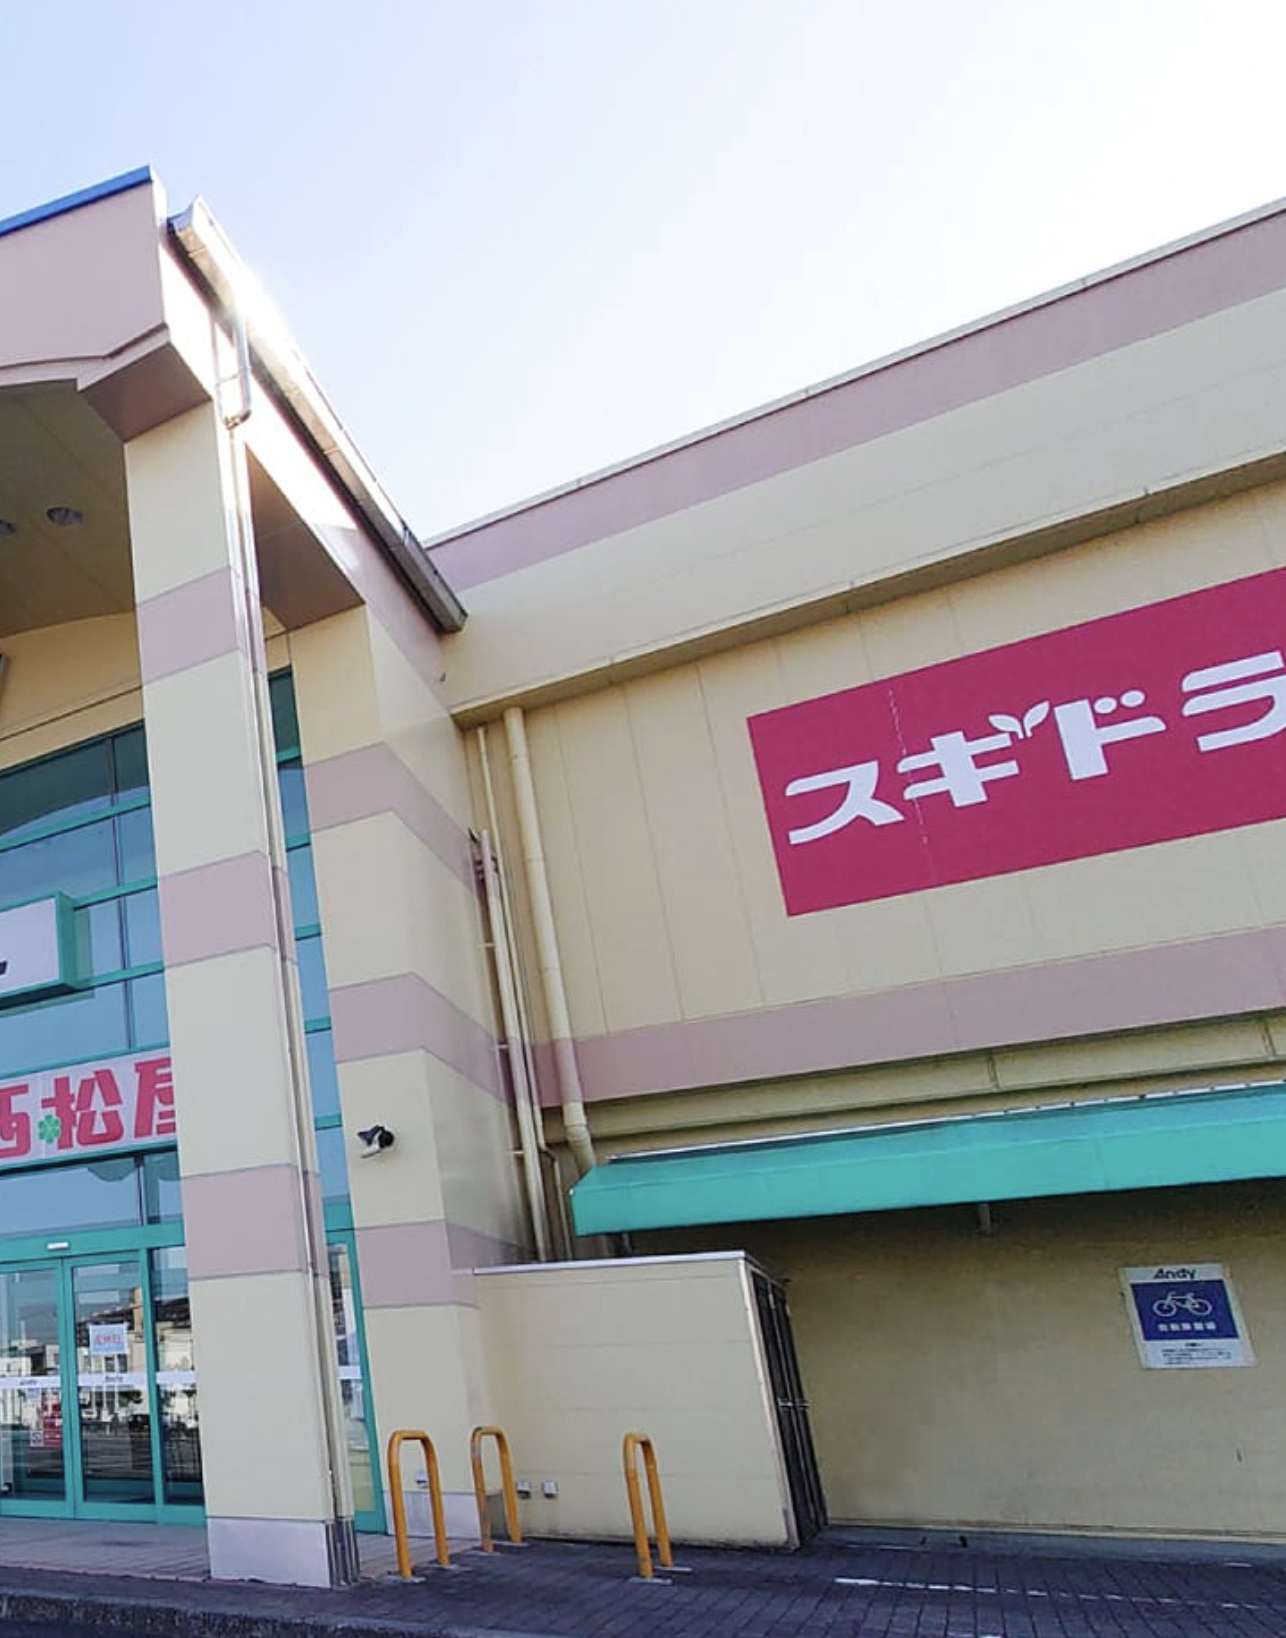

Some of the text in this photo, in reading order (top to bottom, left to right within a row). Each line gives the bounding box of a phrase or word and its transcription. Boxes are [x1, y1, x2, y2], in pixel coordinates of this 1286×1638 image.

[785, 651, 1286, 845] スギドラ
[1154, 1267, 1197, 1279] Andy
